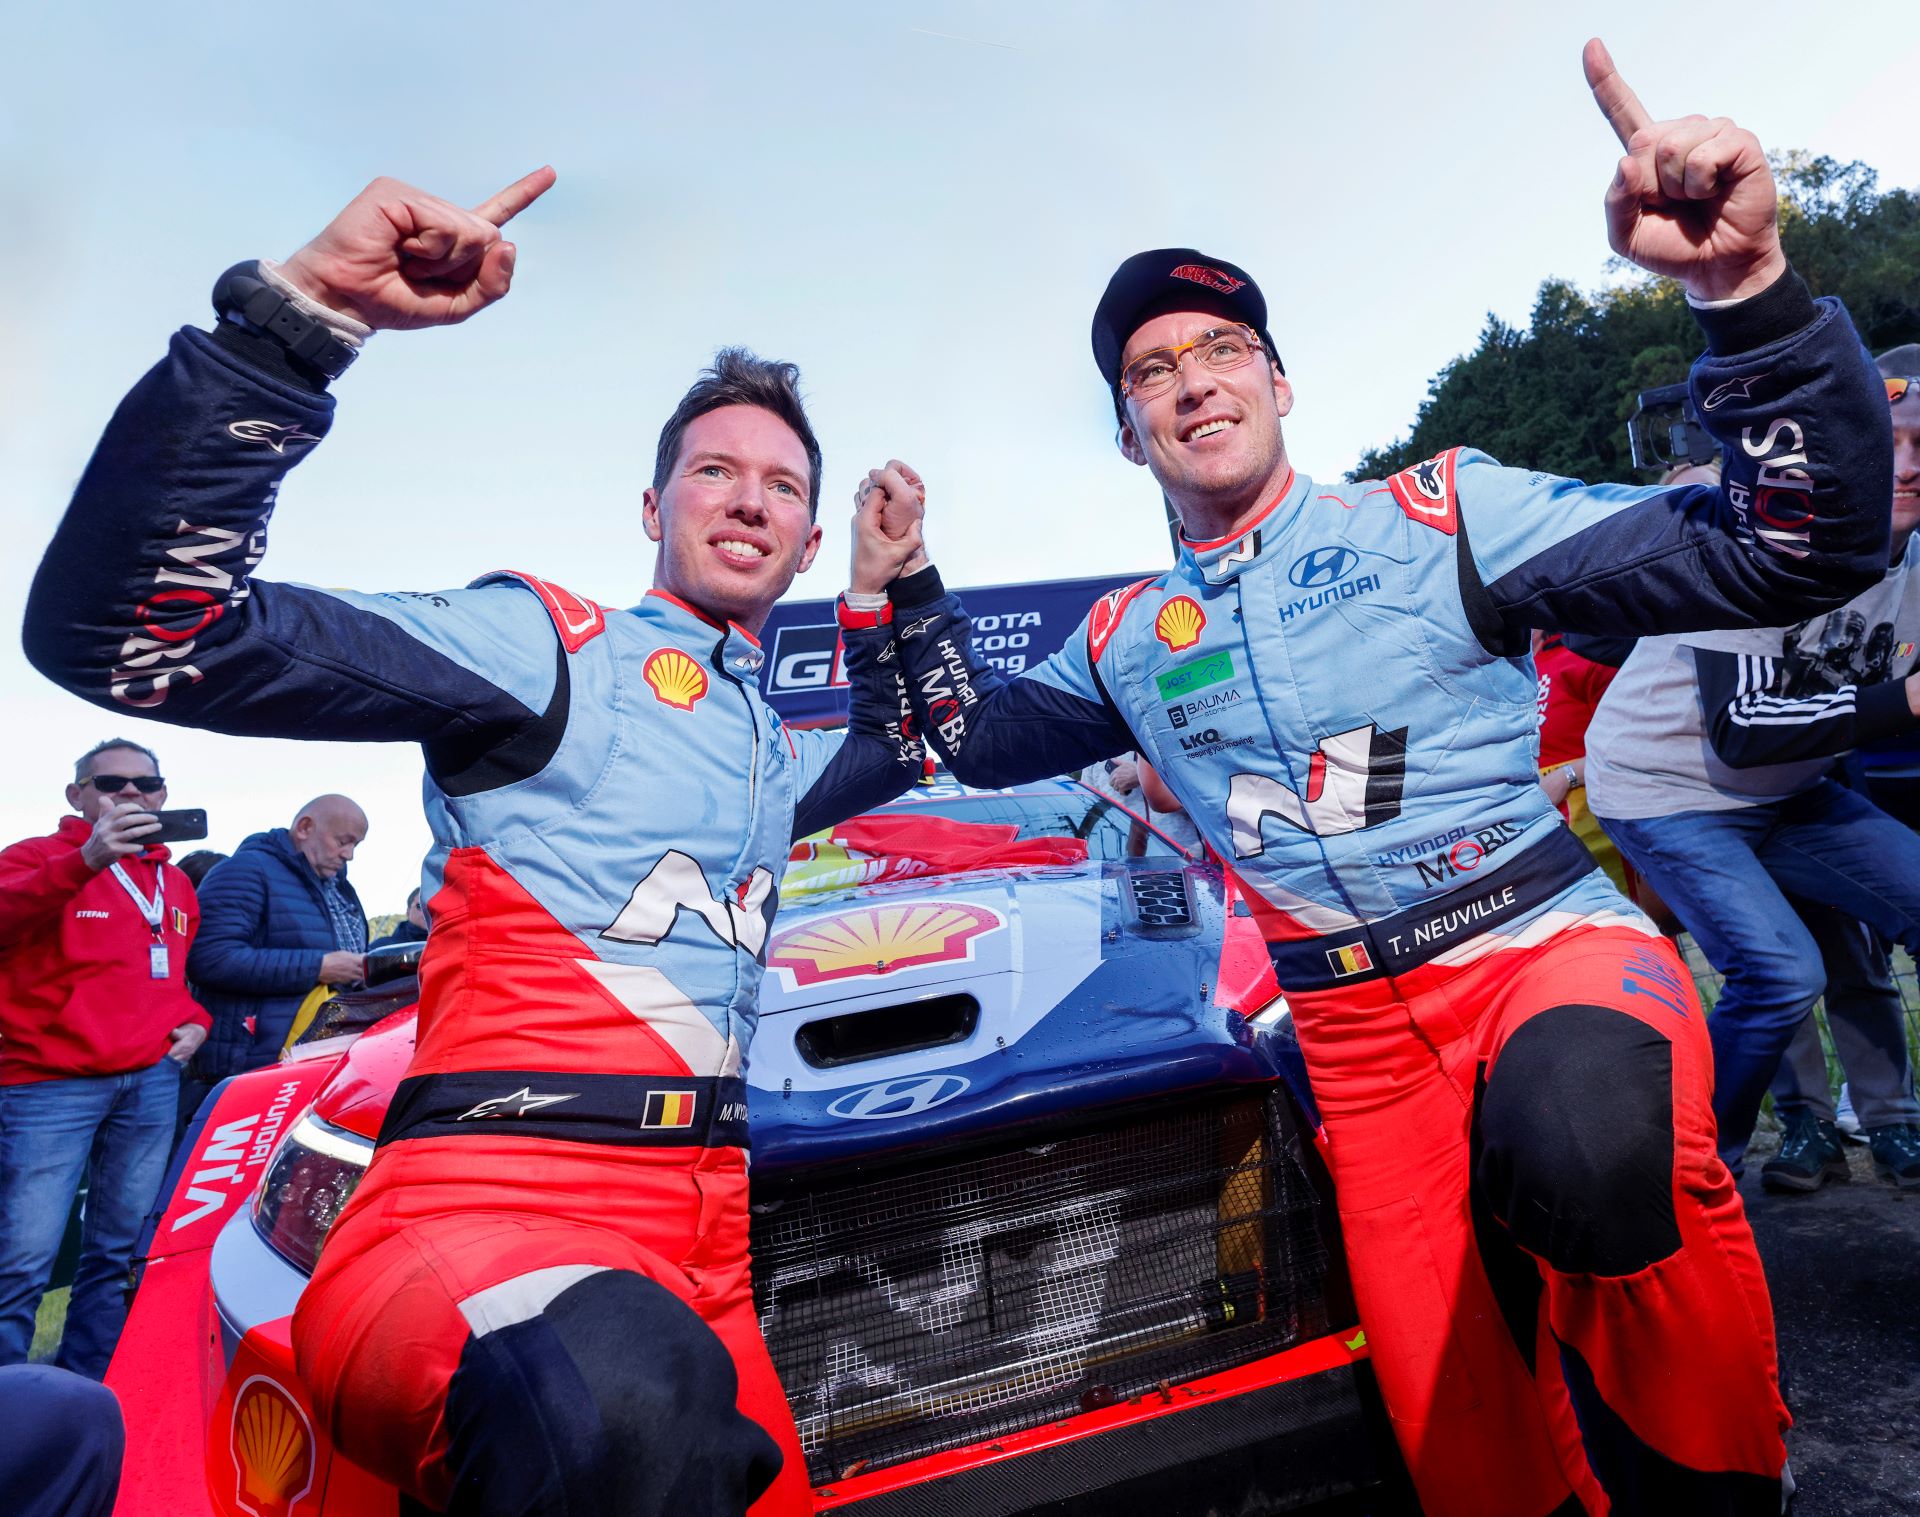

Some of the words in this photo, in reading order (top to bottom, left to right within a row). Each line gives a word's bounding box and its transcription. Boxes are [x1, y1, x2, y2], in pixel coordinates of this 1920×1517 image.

[1279, 573, 1381, 622] HYUNDAI
[775, 650, 852, 688] G
[1165, 671, 1193, 689] JOST
[1186, 689, 1241, 715] BAUMA
[1204, 706, 1227, 717] stone
[1178, 728, 1221, 750] LKQ
[1186, 747, 1213, 760] Keeping
[1211, 743, 1225, 755] you
[1225, 735, 1254, 749] moving
[1378, 826, 1467, 866] HYUNDAI
[76, 910, 109, 919] STEFAN
[1388, 936, 1410, 956] T.
[1414, 886, 1516, 946] NEUVILLE
[246, 1080, 302, 1167] HYUNDAI
